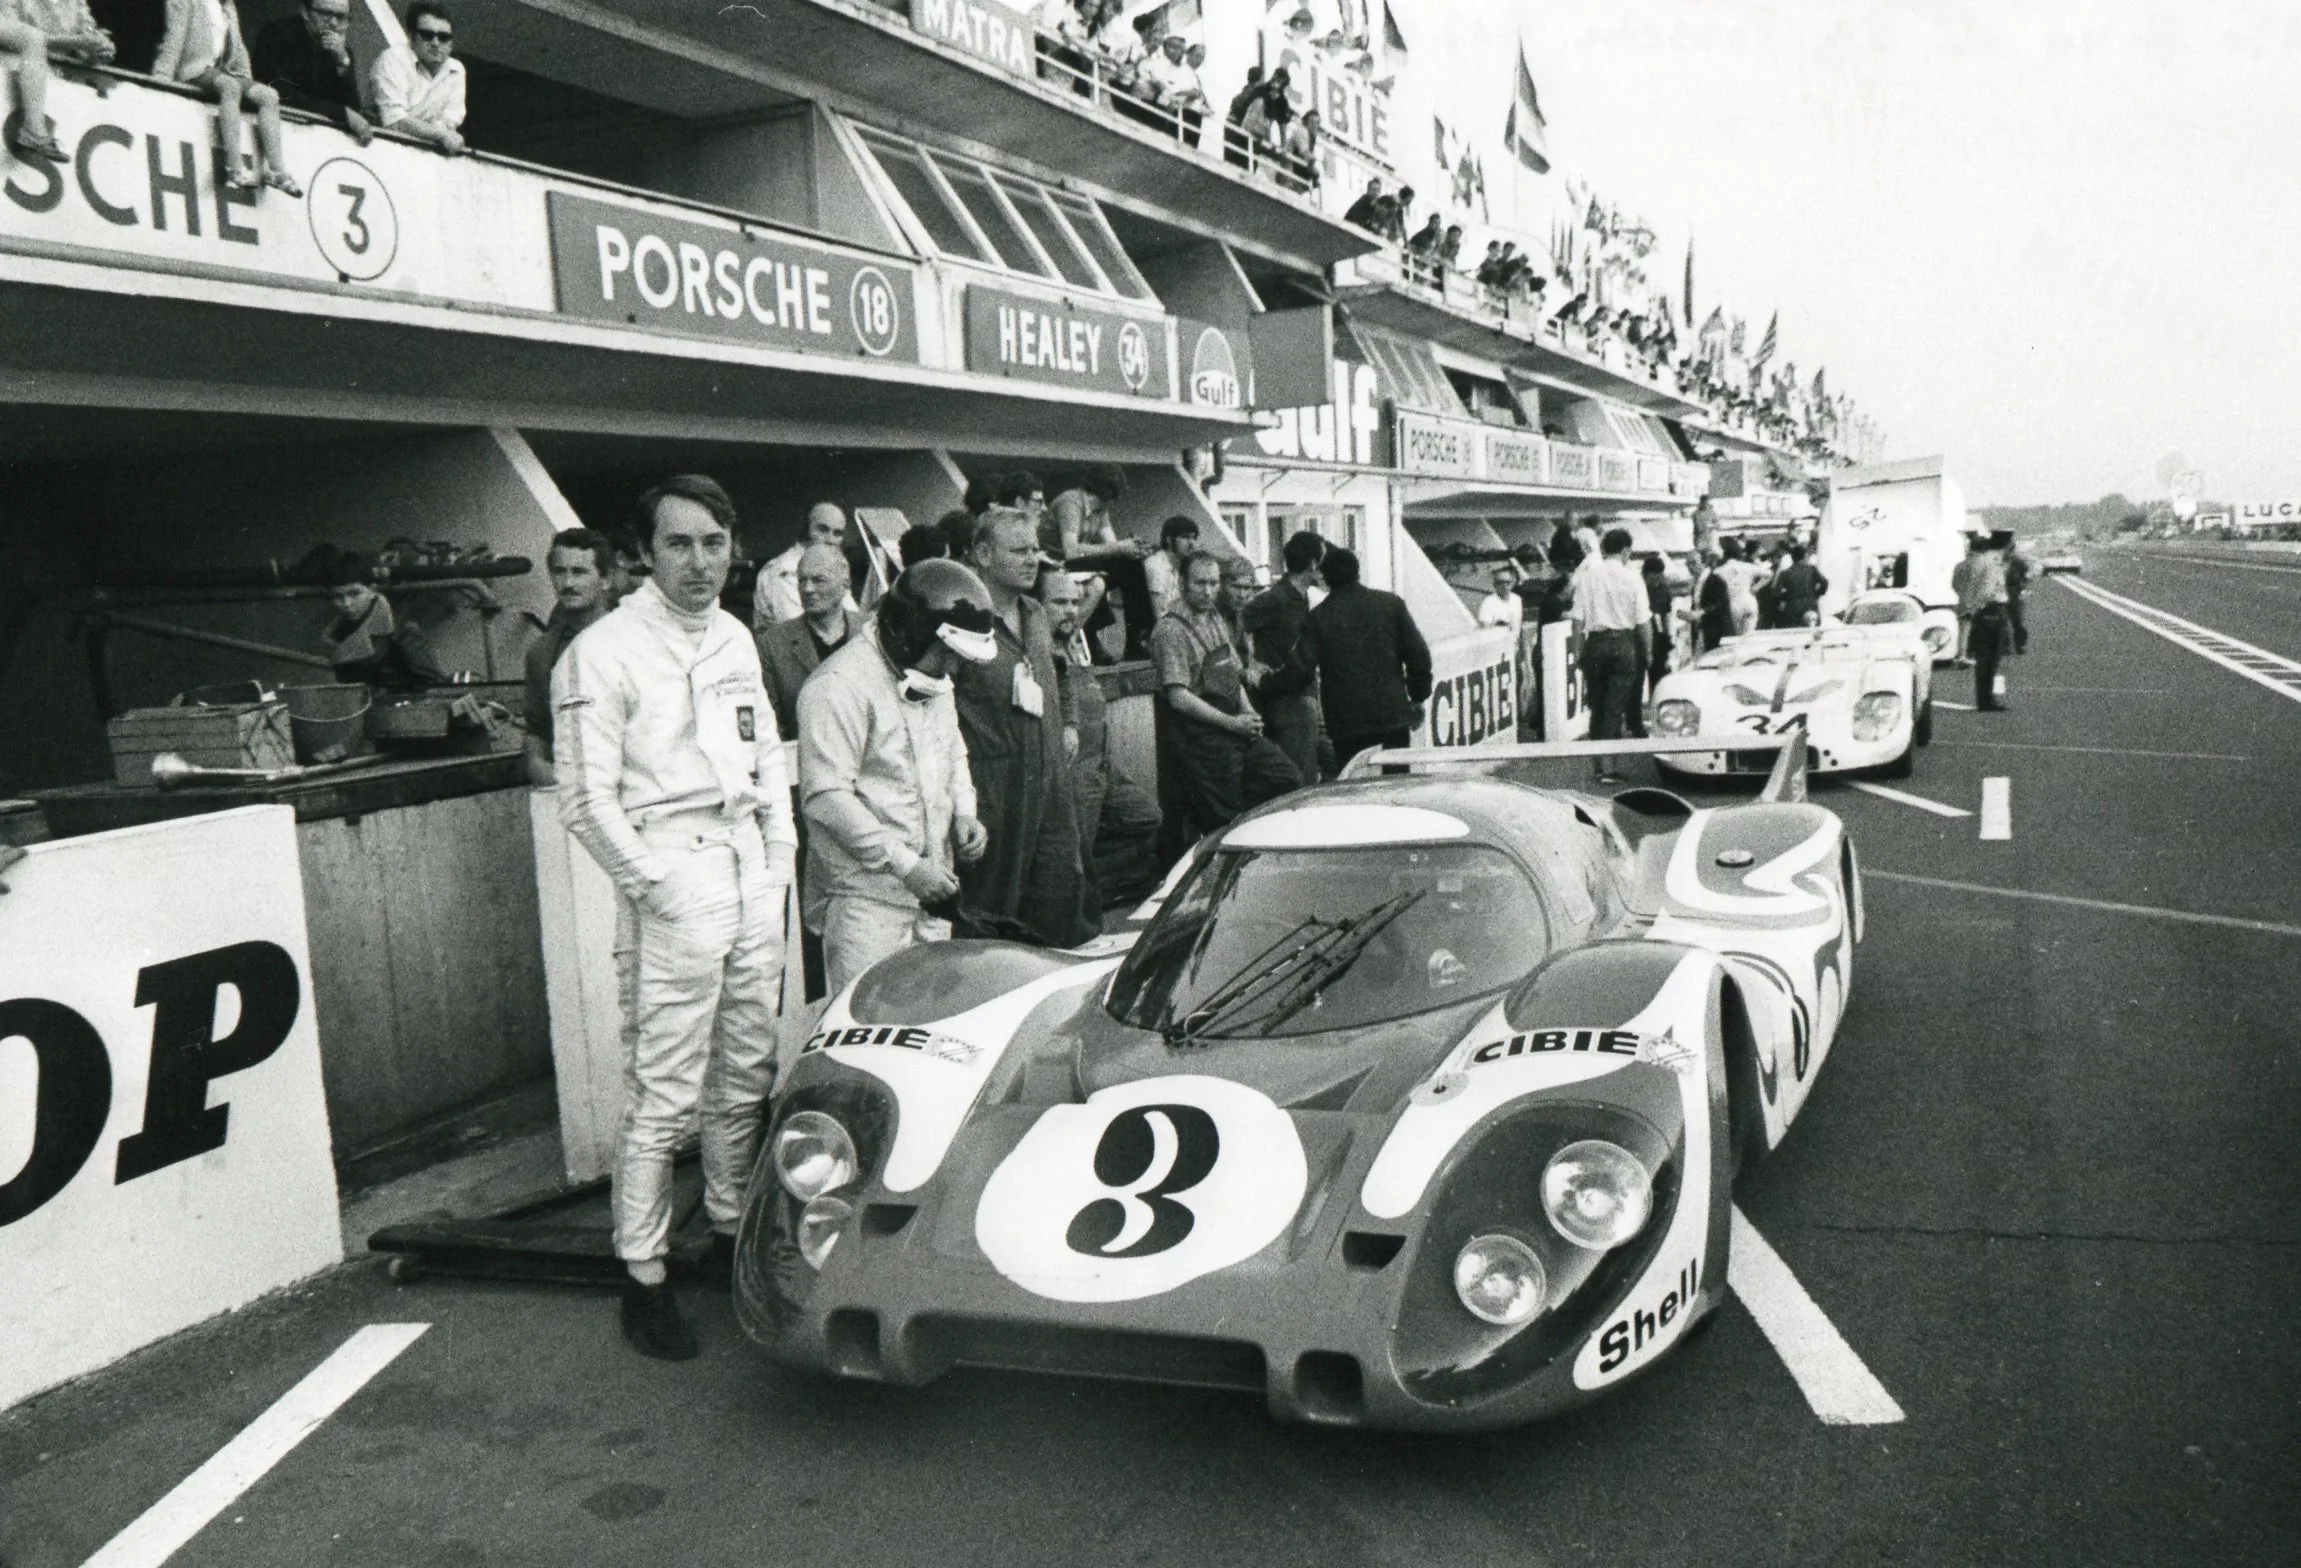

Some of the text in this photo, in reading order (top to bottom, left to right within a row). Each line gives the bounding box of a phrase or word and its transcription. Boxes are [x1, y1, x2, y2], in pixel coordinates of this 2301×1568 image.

[922, 0, 1028, 76] MATRA
[3, 108, 371, 255] SCHE 3
[596, 225, 890, 336] PORSCHE 18
[1000, 305, 1101, 375] HEALEY
[1196, 375, 1235, 406] Gulf
[1066, 1103, 1220, 1258] 3
[1599, 1258, 1697, 1374] Shell
